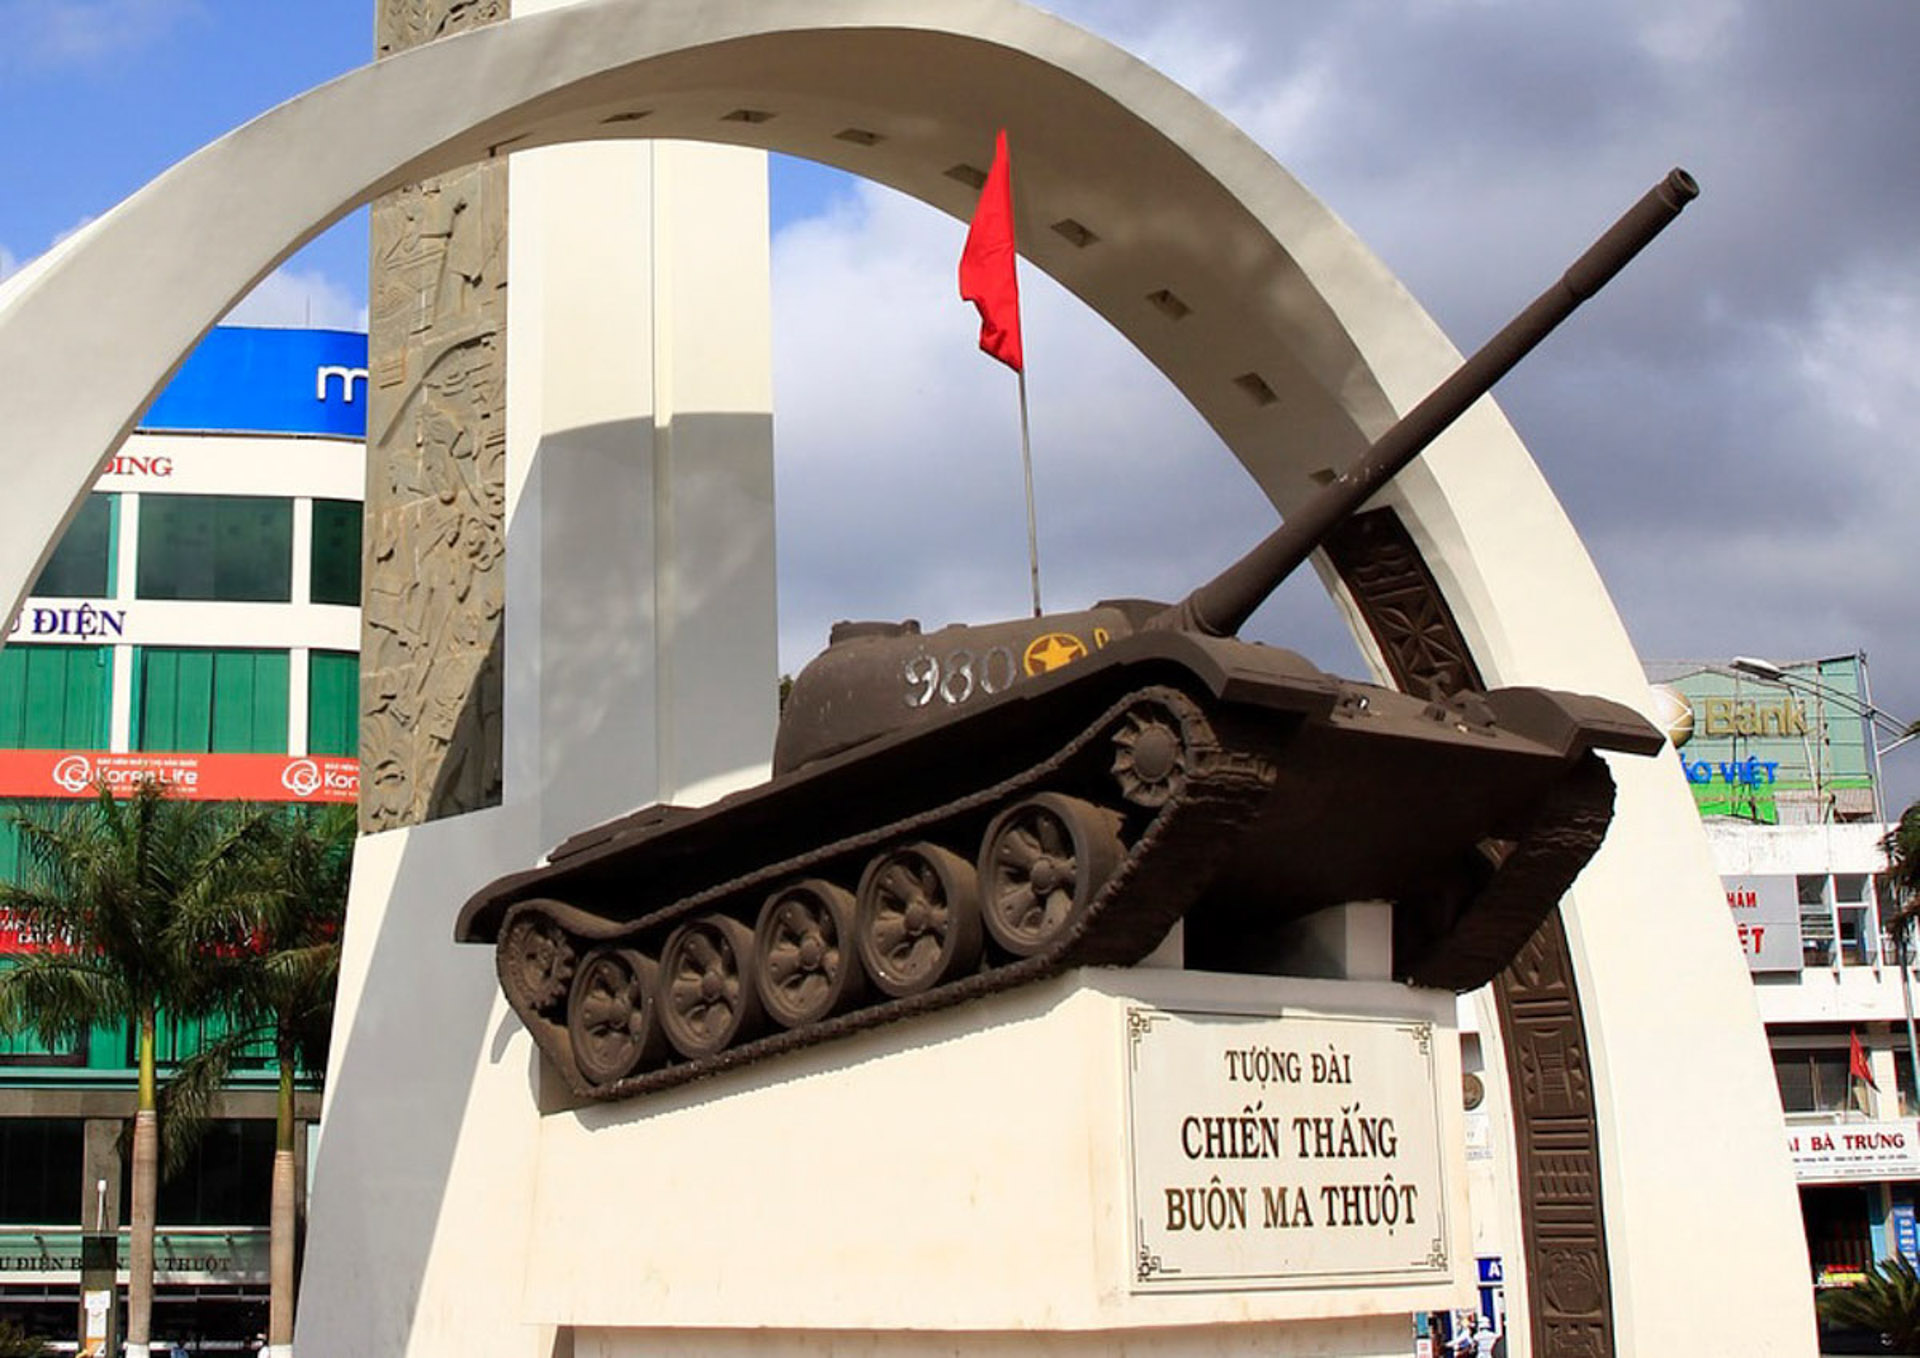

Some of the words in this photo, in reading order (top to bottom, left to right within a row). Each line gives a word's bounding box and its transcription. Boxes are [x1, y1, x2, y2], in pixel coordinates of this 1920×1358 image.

[32, 602, 126, 640] ĐIỆN
[904, 646, 1017, 707] 980
[1705, 698, 1807, 736] Bank
[159, 768, 198, 784] Life
[1224, 1045, 1301, 1090] TƯỢNG
[1312, 1044, 1352, 1084] ĐÀI
[1181, 1100, 1280, 1160] CHIẾN
[1292, 1102, 1397, 1159] THẮNG
[1811, 1132, 1835, 1151] BÀ
[1842, 1131, 1905, 1150] TRƯNG
[1164, 1175, 1247, 1231] BUÔN
[1262, 1186, 1314, 1229] MA
[1320, 1173, 1418, 1236] THUỘT
